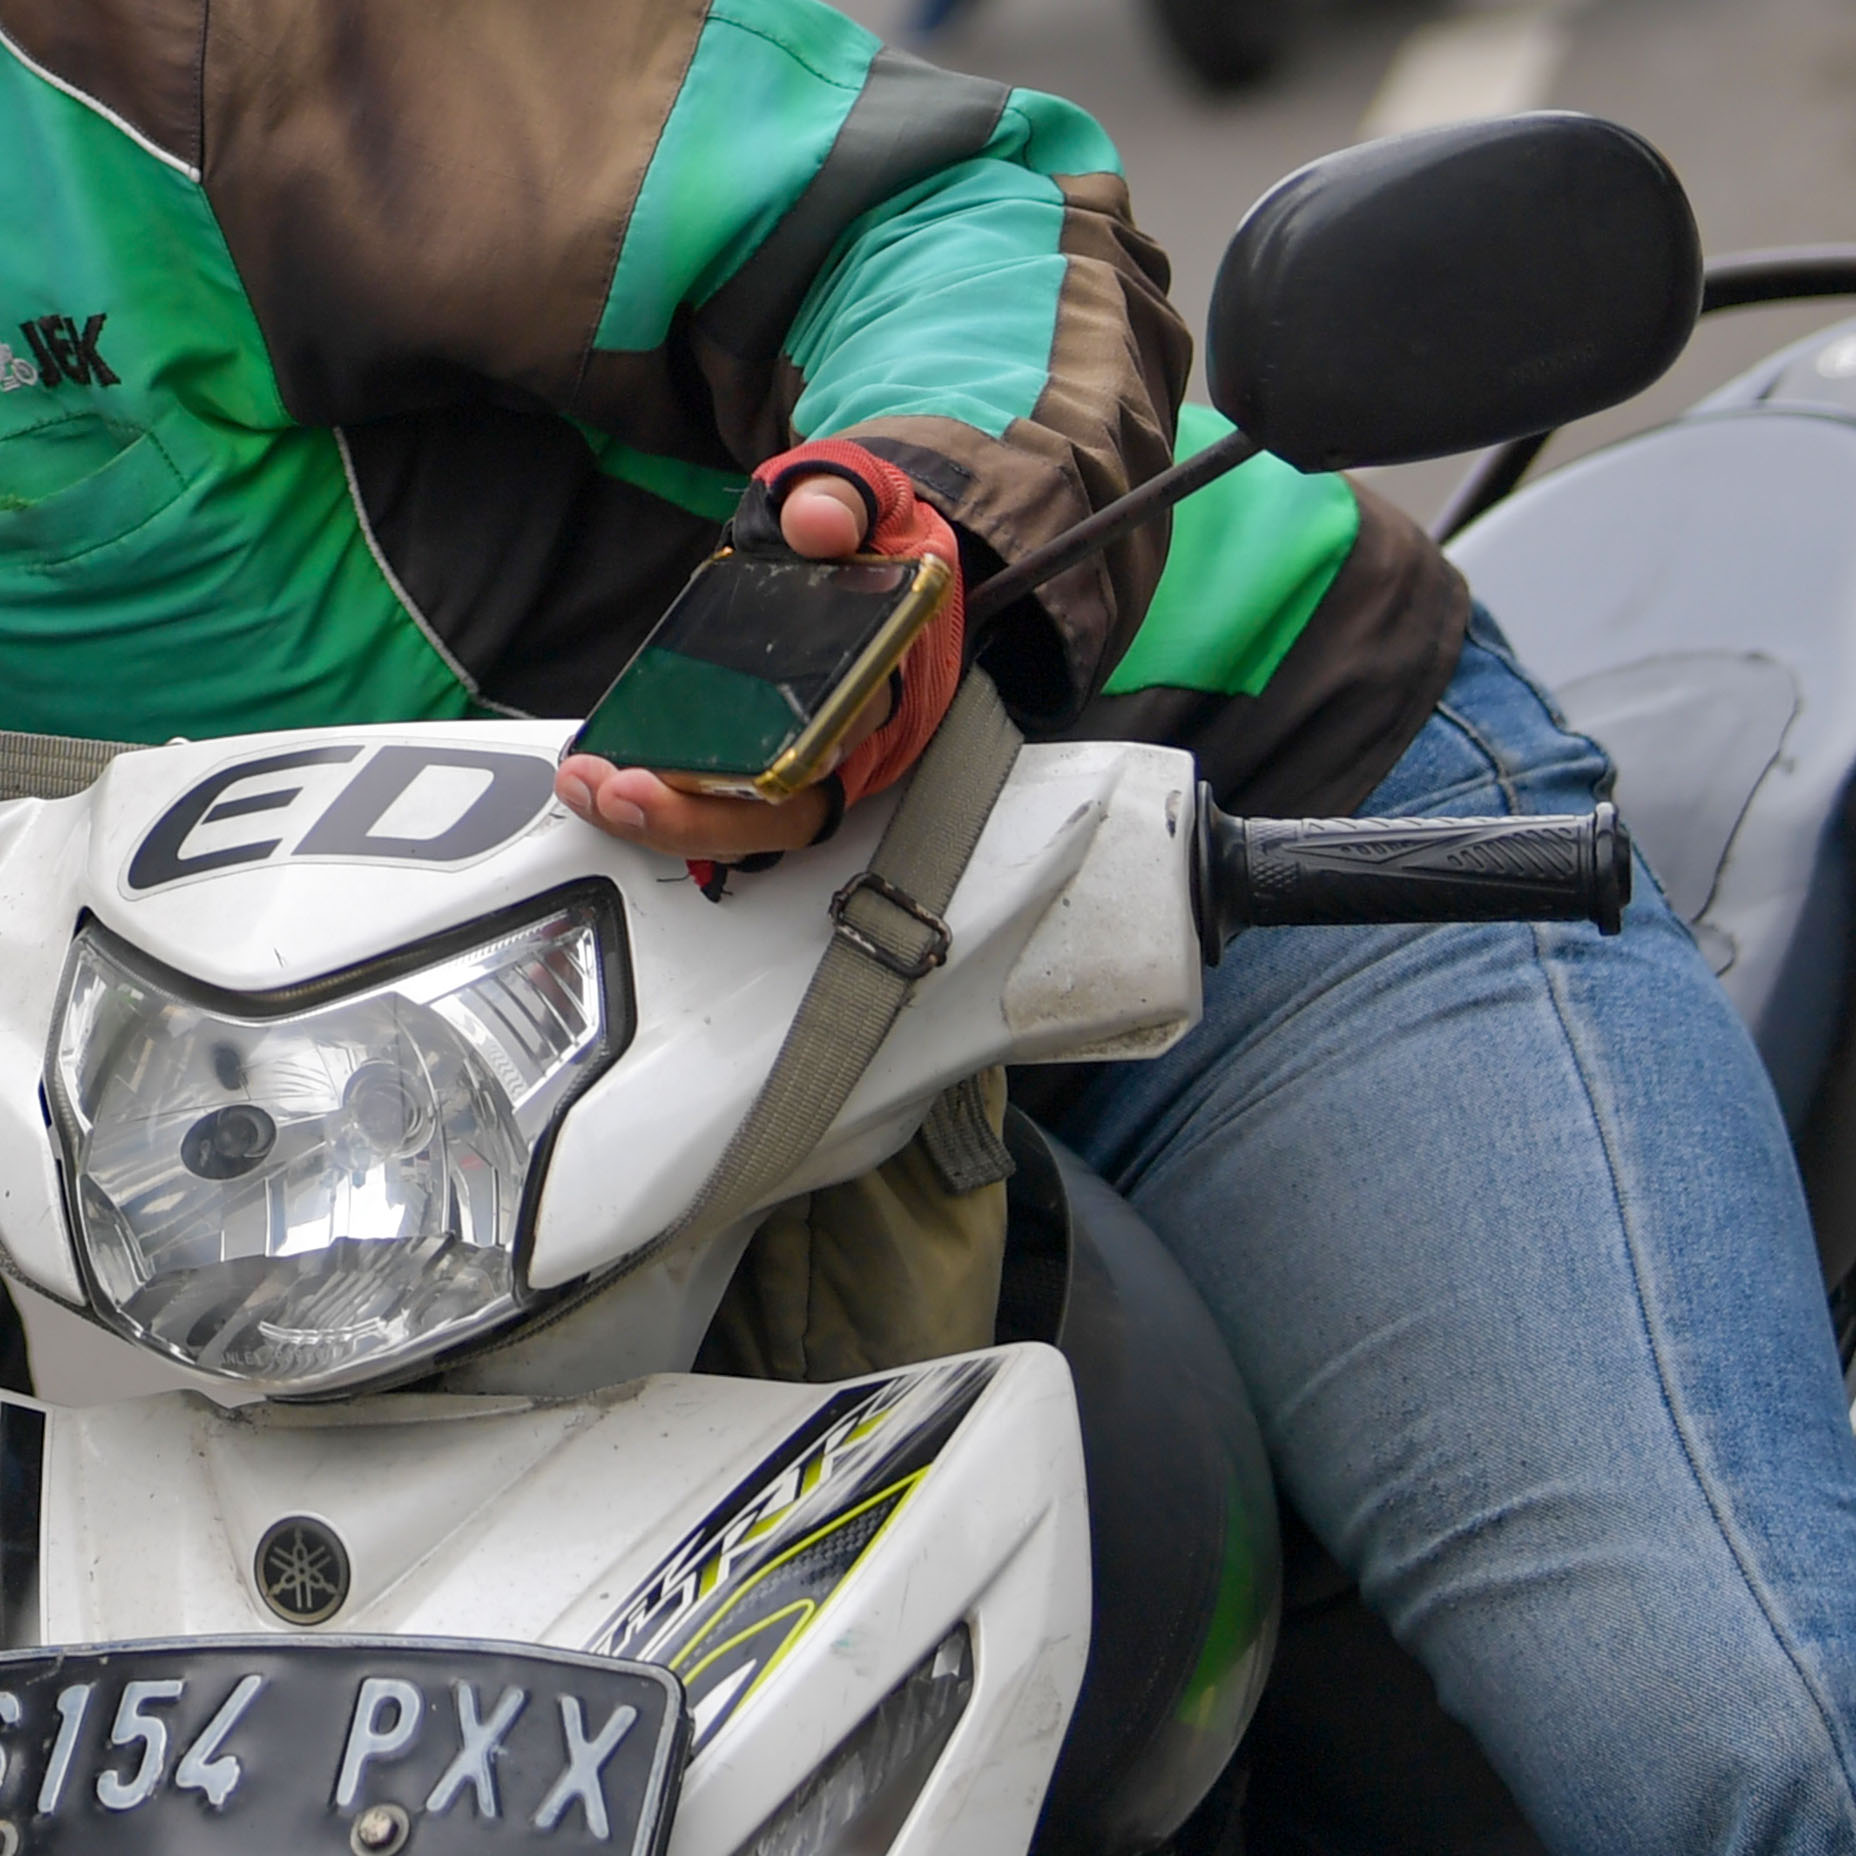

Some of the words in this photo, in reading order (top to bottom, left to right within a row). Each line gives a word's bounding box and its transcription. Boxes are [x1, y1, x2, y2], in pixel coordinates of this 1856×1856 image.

[19, 310, 122, 391] JEK
[126, 744, 558, 891] ED
[336, 1677, 638, 1842] PXX
